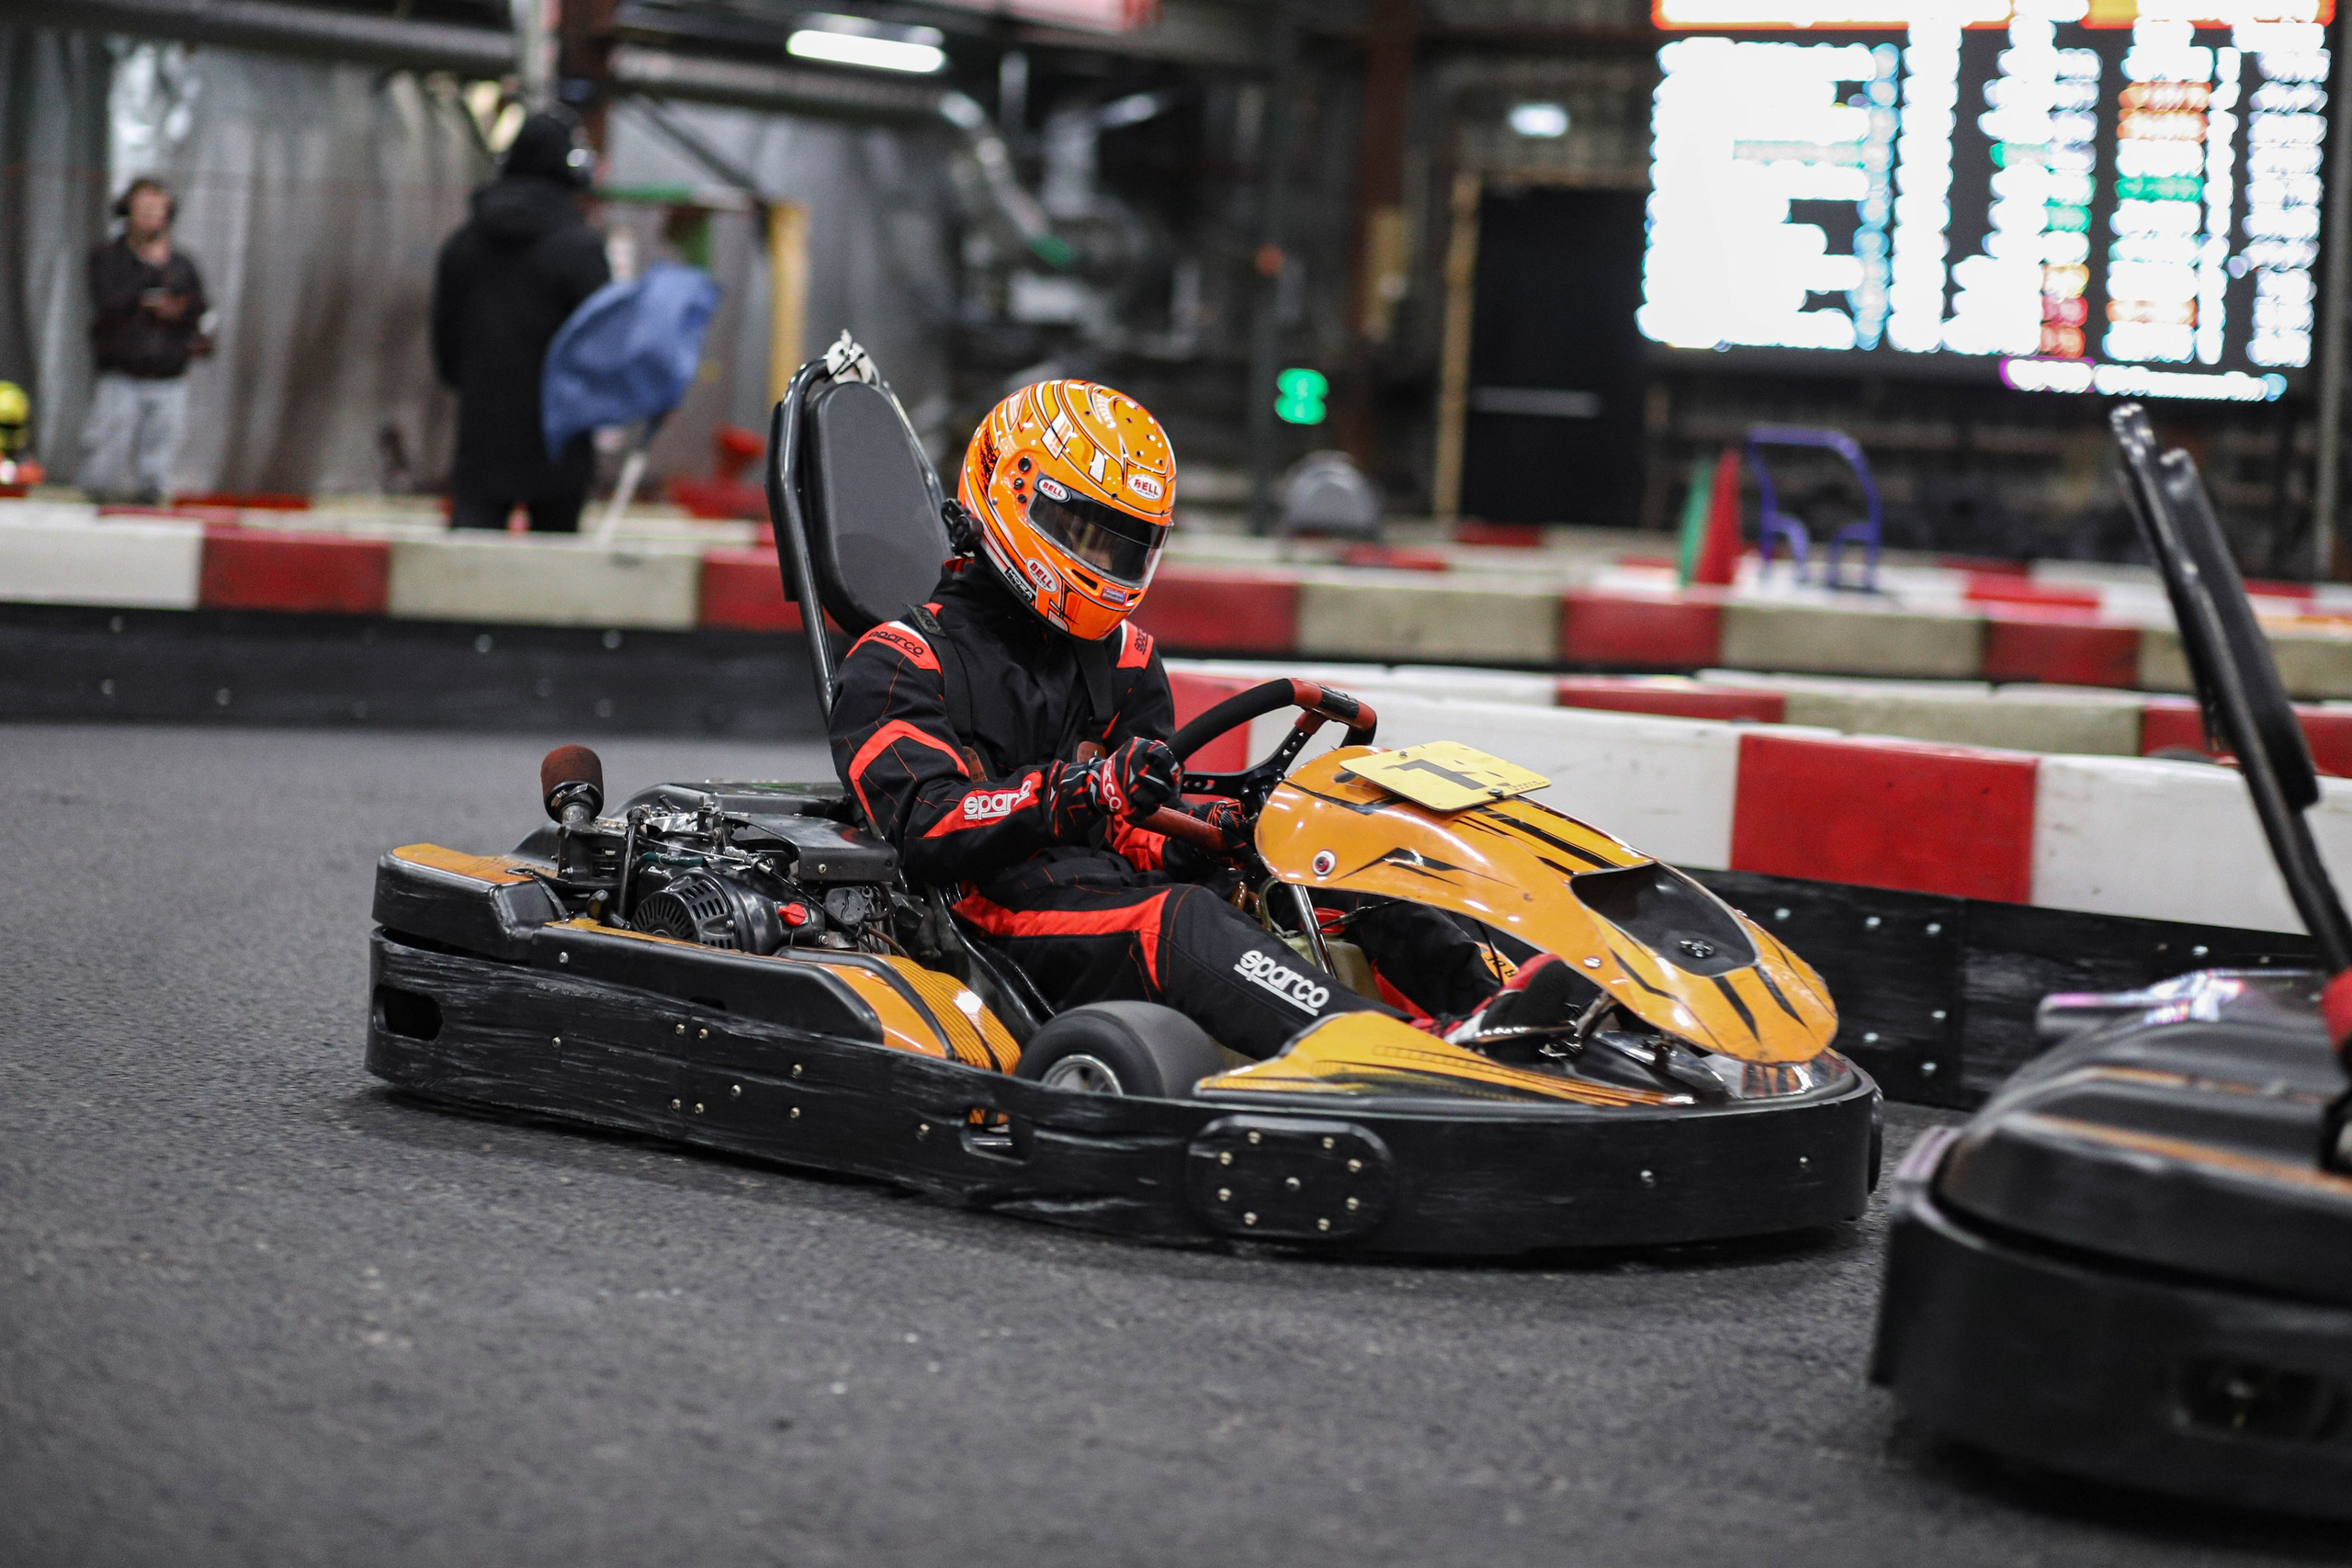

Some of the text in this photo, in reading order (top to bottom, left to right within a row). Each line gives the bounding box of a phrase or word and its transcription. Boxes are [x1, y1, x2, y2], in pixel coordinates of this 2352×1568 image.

[1043, 481, 1063, 498] BELL
[1134, 479, 1159, 495] BELL
[1009, 570, 1033, 598] MOZA
[1030, 562, 1052, 589] BELL
[867, 631, 924, 656] sparco
[1238, 950, 1330, 1010] sparco
